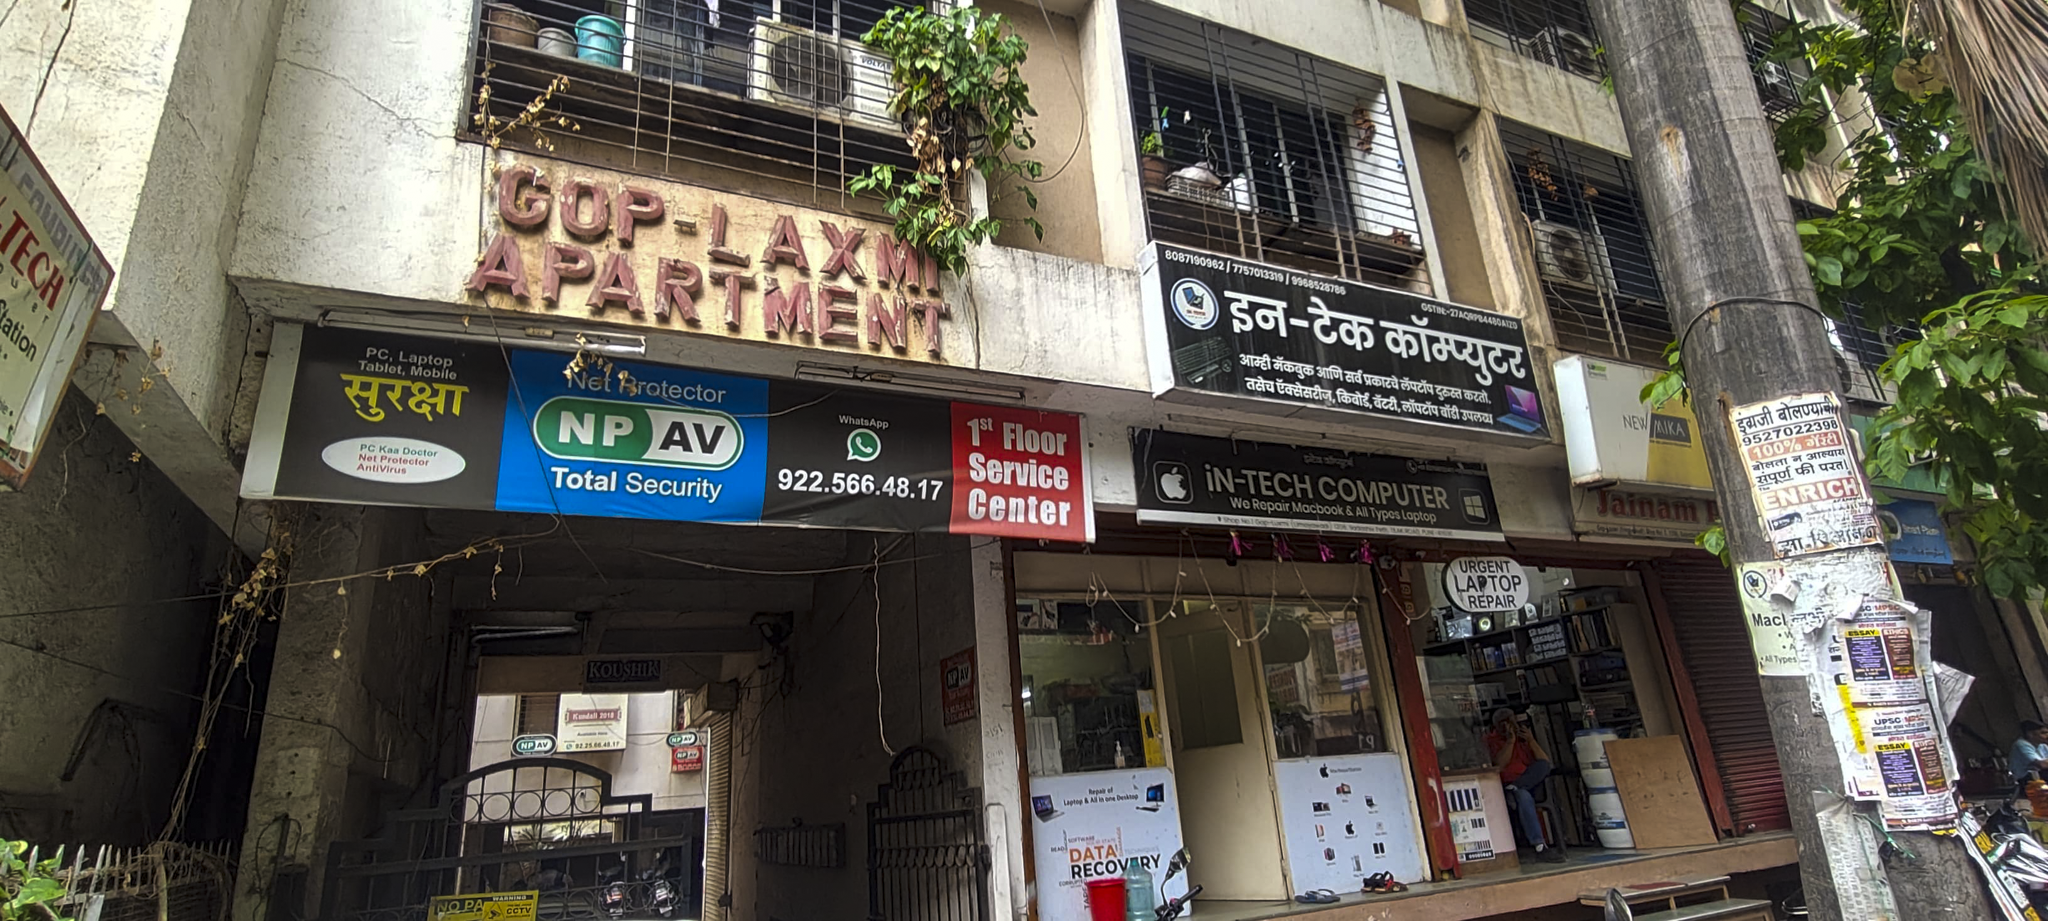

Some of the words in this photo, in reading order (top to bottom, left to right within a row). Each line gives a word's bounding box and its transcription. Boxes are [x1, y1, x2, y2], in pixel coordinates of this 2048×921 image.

[1165, 250, 1225, 271] 8087190962
[1232, 263, 1284, 283] 7757013319
[464, 234, 950, 356] APARTMENT
[1224, 291, 1374, 351] इन-टेक
[1379, 315, 1526, 386] कॉम्प्युटर
[366, 347, 394, 362] PC,
[398, 351, 454, 369] Laptop
[358, 360, 406, 376] Tablet,
[410, 364, 458, 380] Mobile
[1239, 354, 1271, 371] आम्ही
[1316, 365, 1343, 381] आणि
[1344, 370, 1363, 384] सर्व
[1363, 373, 1400, 390] प्रकारचे
[1400, 377, 1435, 395] लॅपटॉप
[568, 372, 611, 393] Net
[620, 376, 726, 403] Protector
[1244, 376, 1275, 393] तसेच
[340, 373, 470, 422] सुरक्षा
[839, 414, 889, 430] WhatsApp
[1623, 412, 1649, 431] NEW
[1653, 419, 1686, 440] MIKA
[558, 411, 634, 447] NP
[659, 421, 726, 455] AV
[967, 417, 993, 447] 1st
[1003, 422, 1068, 456] Floor
[1742, 420, 1839, 446] 9527022398
[360, 443, 376, 453] PC
[379, 445, 400, 455] Kaa
[402, 447, 438, 458] Doctor
[1753, 439, 1802, 460] 100%
[356, 463, 407, 475] AntiVirus
[358, 454, 378, 464] Net
[380, 455, 429, 467] Protector
[1752, 457, 1788, 472] बोलता
[1795, 462, 1816, 476] फी
[968, 452, 1069, 490] Service
[551, 467, 617, 492] Total
[626, 472, 722, 504] Security
[778, 468, 943, 501] 922.566.48.17
[1204, 463, 1314, 499] iN-TECH
[1318, 476, 1450, 510] COMPUTER
[1762, 478, 1859, 509] ENRICH
[968, 488, 1071, 526] Center
[1230, 497, 1250, 509] We
[1252, 499, 1290, 514] Repair
[1292, 501, 1343, 516] Macbook
[1346, 505, 1354, 515] &
[1356, 506, 1369, 518] All
[1370, 507, 1401, 522] Types
[1402, 510, 1437, 525] Laptop
[1596, 489, 1697, 522] Jainam
[1459, 560, 1511, 574] URGENT
[1454, 575, 1521, 593] LAPTOP
[1468, 595, 1517, 609] REPAIR
[1752, 613, 1786, 627] Mac
[588, 660, 661, 680] KOUSHIK
[1774, 655, 1797, 666] Types
[1874, 717, 1901, 725] UPSC
[521, 741, 534, 750] NP
[1878, 742, 1906, 750] ESSAY
[1063, 797, 1083, 806] Laptop
[1084, 796, 1089, 804] &
[1117, 793, 1139, 803] Desktop
[1089, 788, 1106, 797] Repair
[1108, 786, 1113, 794] of
[1068, 836, 1095, 844] SOFTWARE
[1069, 844, 1117, 864] DATA
[439, 900, 460, 913] NO
[506, 907, 531, 915] CCTV
